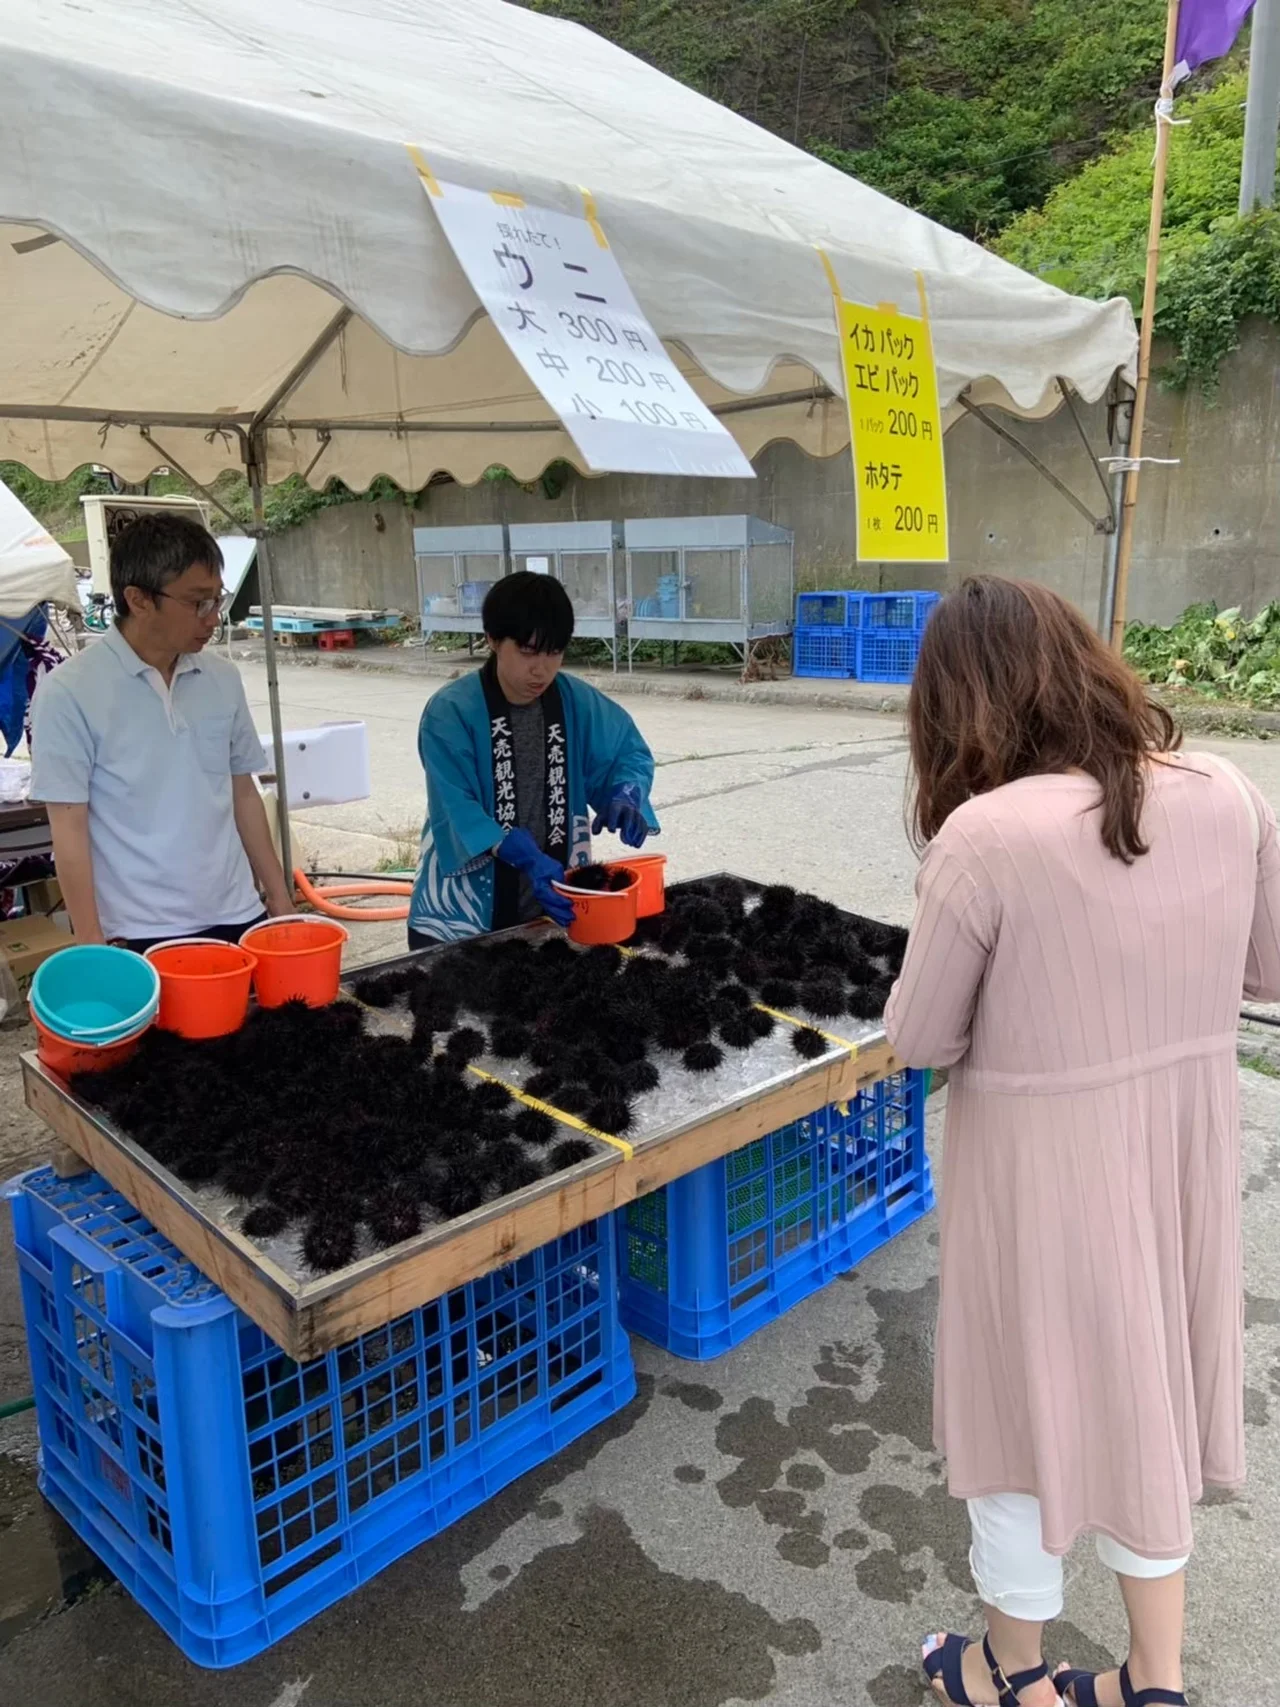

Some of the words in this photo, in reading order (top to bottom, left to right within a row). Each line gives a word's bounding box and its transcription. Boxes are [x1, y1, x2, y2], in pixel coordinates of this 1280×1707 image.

[493, 242, 607, 304] ウニ
[507, 301, 547, 334] 大
[558, 311, 648, 352] 300円
[536, 348, 570, 379] 中
[586, 356, 676, 393] 200円
[571, 393, 603, 420] 小
[620, 399, 708, 430] 100円
[888, 408, 933, 441] 200円
[864, 461, 903, 491] ホタテ
[895, 505, 938, 534] 200円
[546, 723, 567, 847] 天売観光協会
